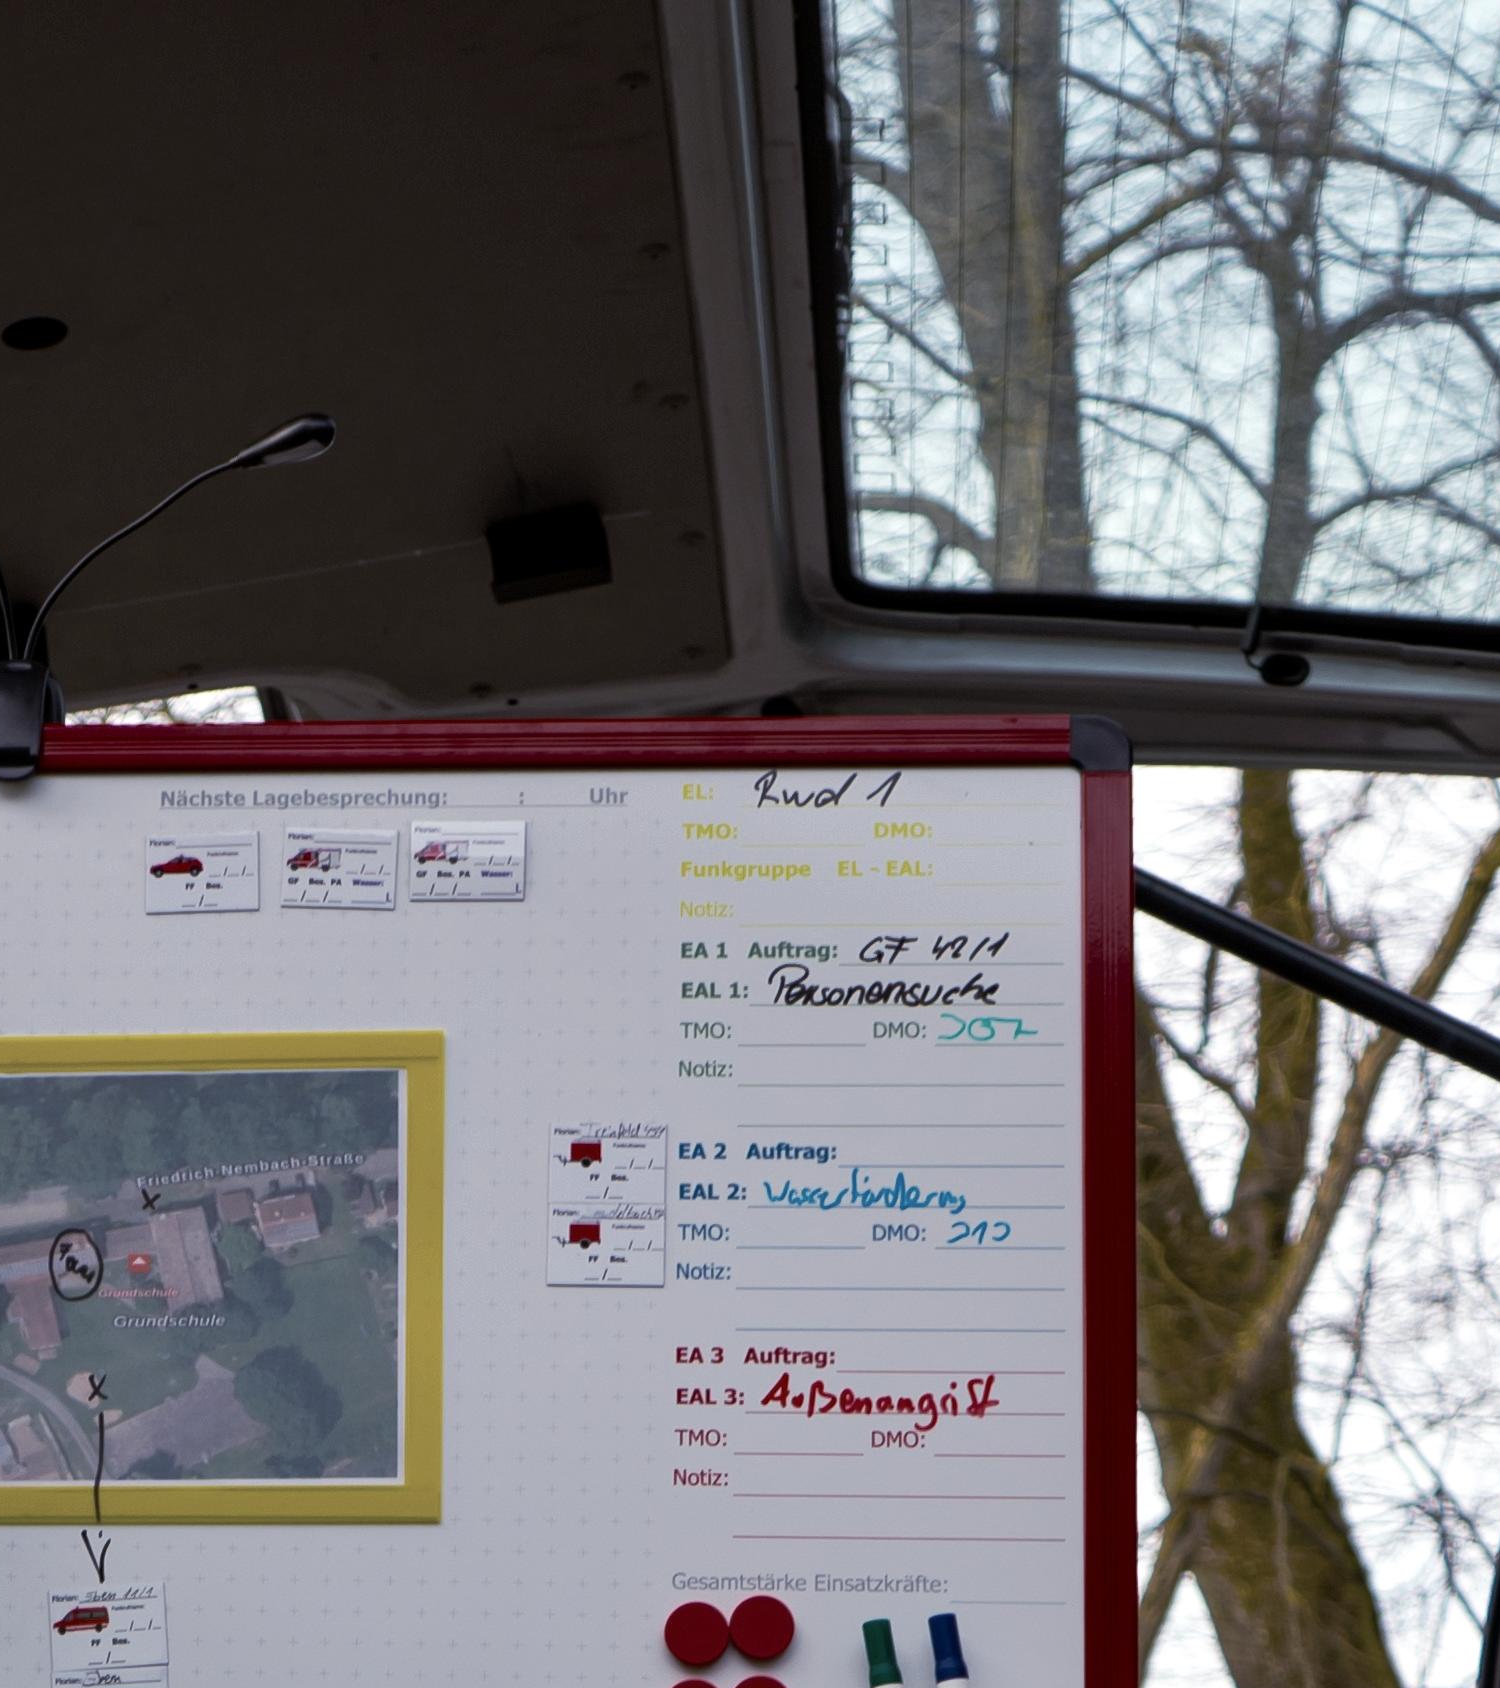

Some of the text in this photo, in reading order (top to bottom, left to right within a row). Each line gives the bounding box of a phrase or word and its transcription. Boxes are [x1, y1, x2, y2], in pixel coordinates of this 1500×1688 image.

[682, 784, 714, 800] EL:
[866, 770, 902, 807] 1
[160, 789, 247, 808] Nächste
[253, 788, 448, 811] Lagebesprechung:
[589, 788, 629, 806] Uhr
[683, 822, 933, 840] TMO: DMO:
[681, 861, 811, 881] Funkgruppe
[838, 860, 863, 877] EL
[886, 860, 933, 877] EAL:
[680, 902, 734, 918] Notiz:
[681, 942, 838, 963] EA 1 Auftrag:
[681, 983, 749, 999] EAL 1:
[767, 963, 1000, 1007] Personensuche
[680, 1022, 927, 1039] TMO: DMO:
[678, 1062, 733, 1078] Notiz:
[678, 1143, 837, 1164] EA 2 Auftrag:
[679, 1184, 747, 1201] EAL 2:
[678, 1224, 926, 1241] TMO: DMO:
[676, 1264, 731, 1280] Notiz:
[113, 1314, 226, 1329] Grundschule
[675, 1347, 836, 1368] EA 3 Auftrag:
[676, 1388, 745, 1405] EAL 3:
[675, 1430, 926, 1448] TMO: DMO:
[673, 1469, 729, 1487] Notiz:
[671, 1571, 949, 1594] Gesamtstärke Einsatzkräfte:
